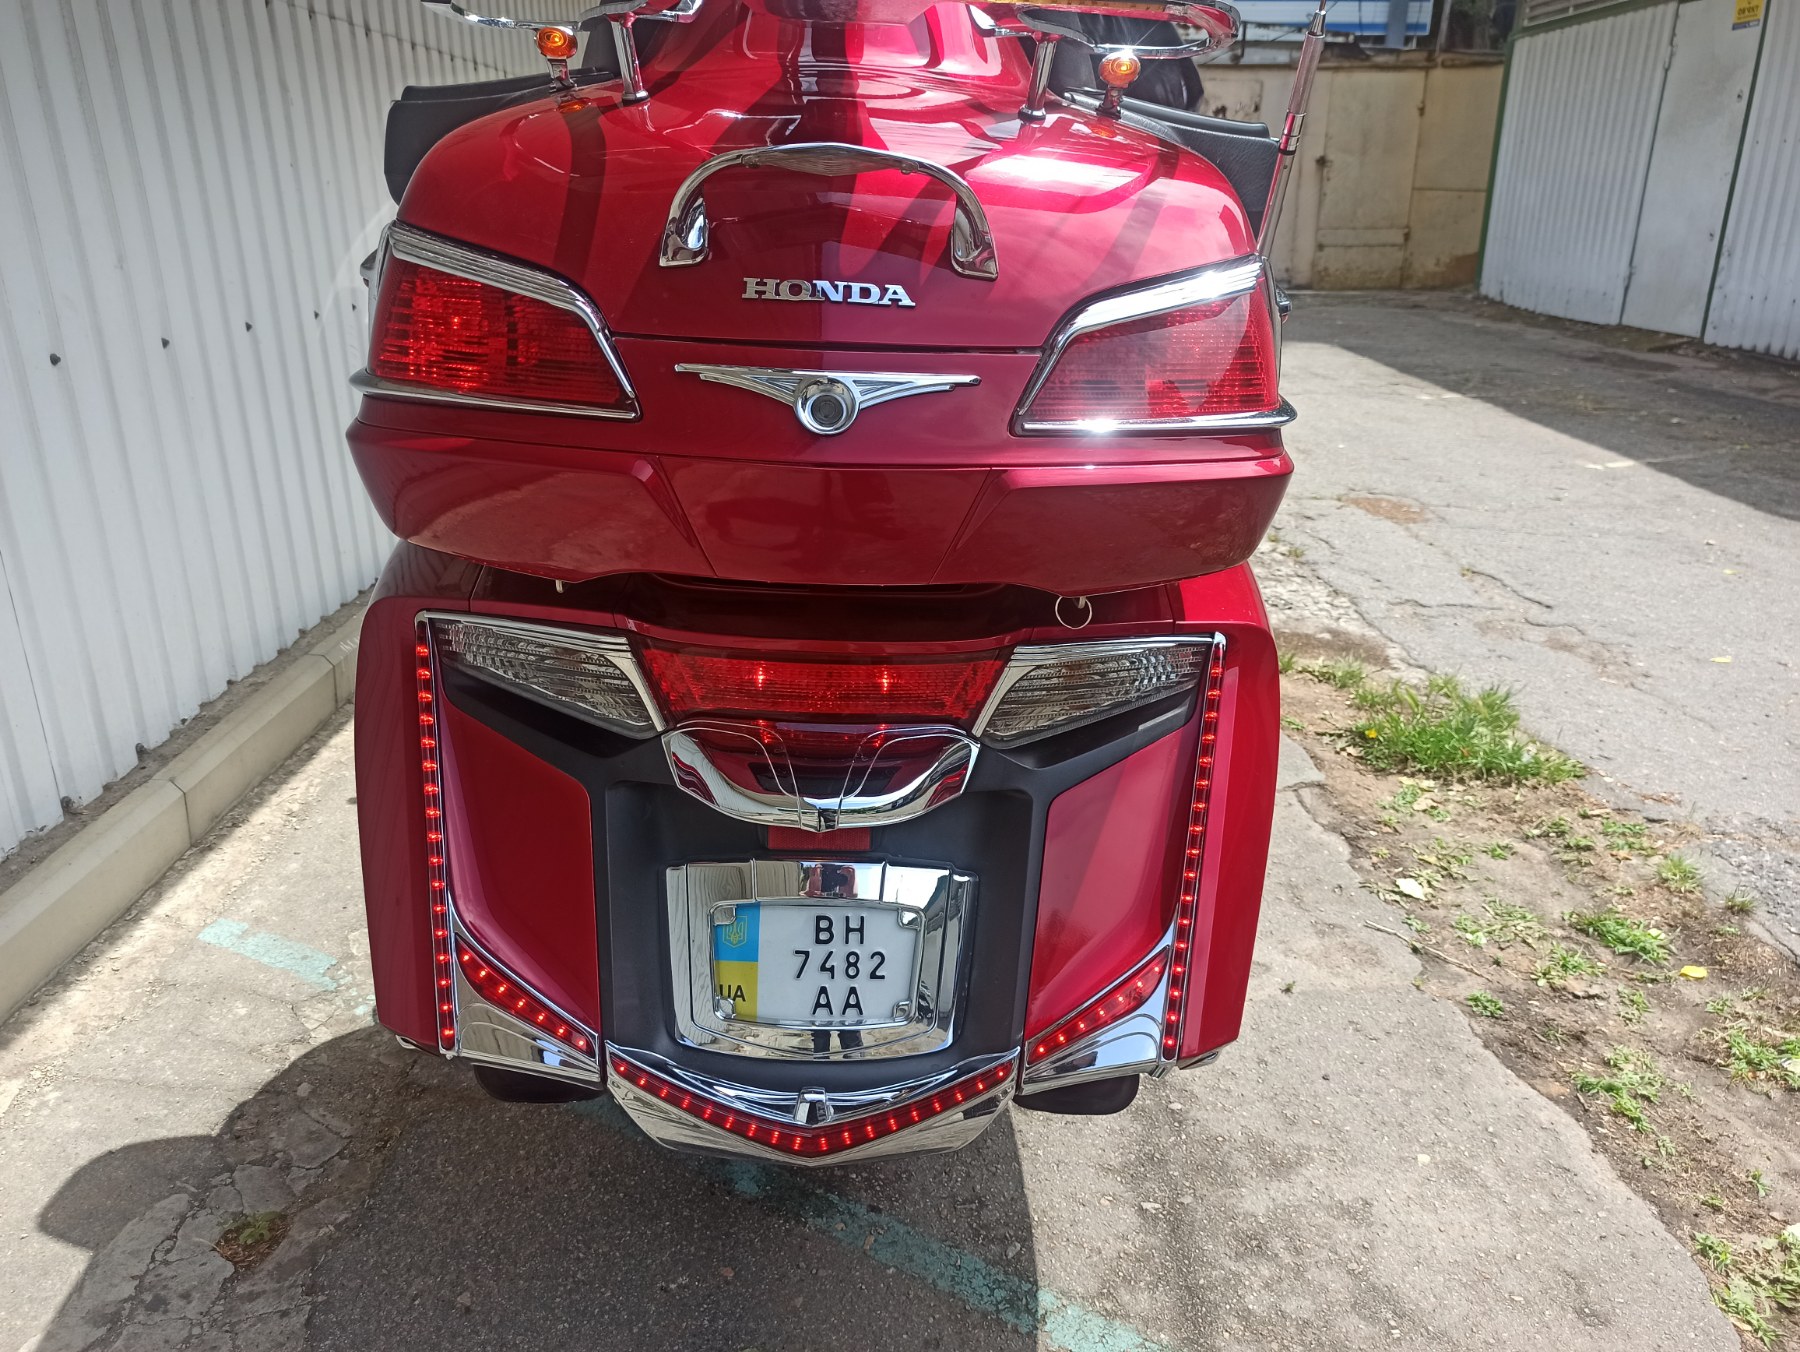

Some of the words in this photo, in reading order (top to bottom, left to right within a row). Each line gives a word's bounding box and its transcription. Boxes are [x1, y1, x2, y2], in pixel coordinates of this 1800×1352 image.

[742, 277, 916, 307] HONDA
[814, 915, 865, 944] BH
[794, 950, 886, 980] 7482
[719, 984, 747, 1002] UA
[812, 986, 863, 1015] AA
